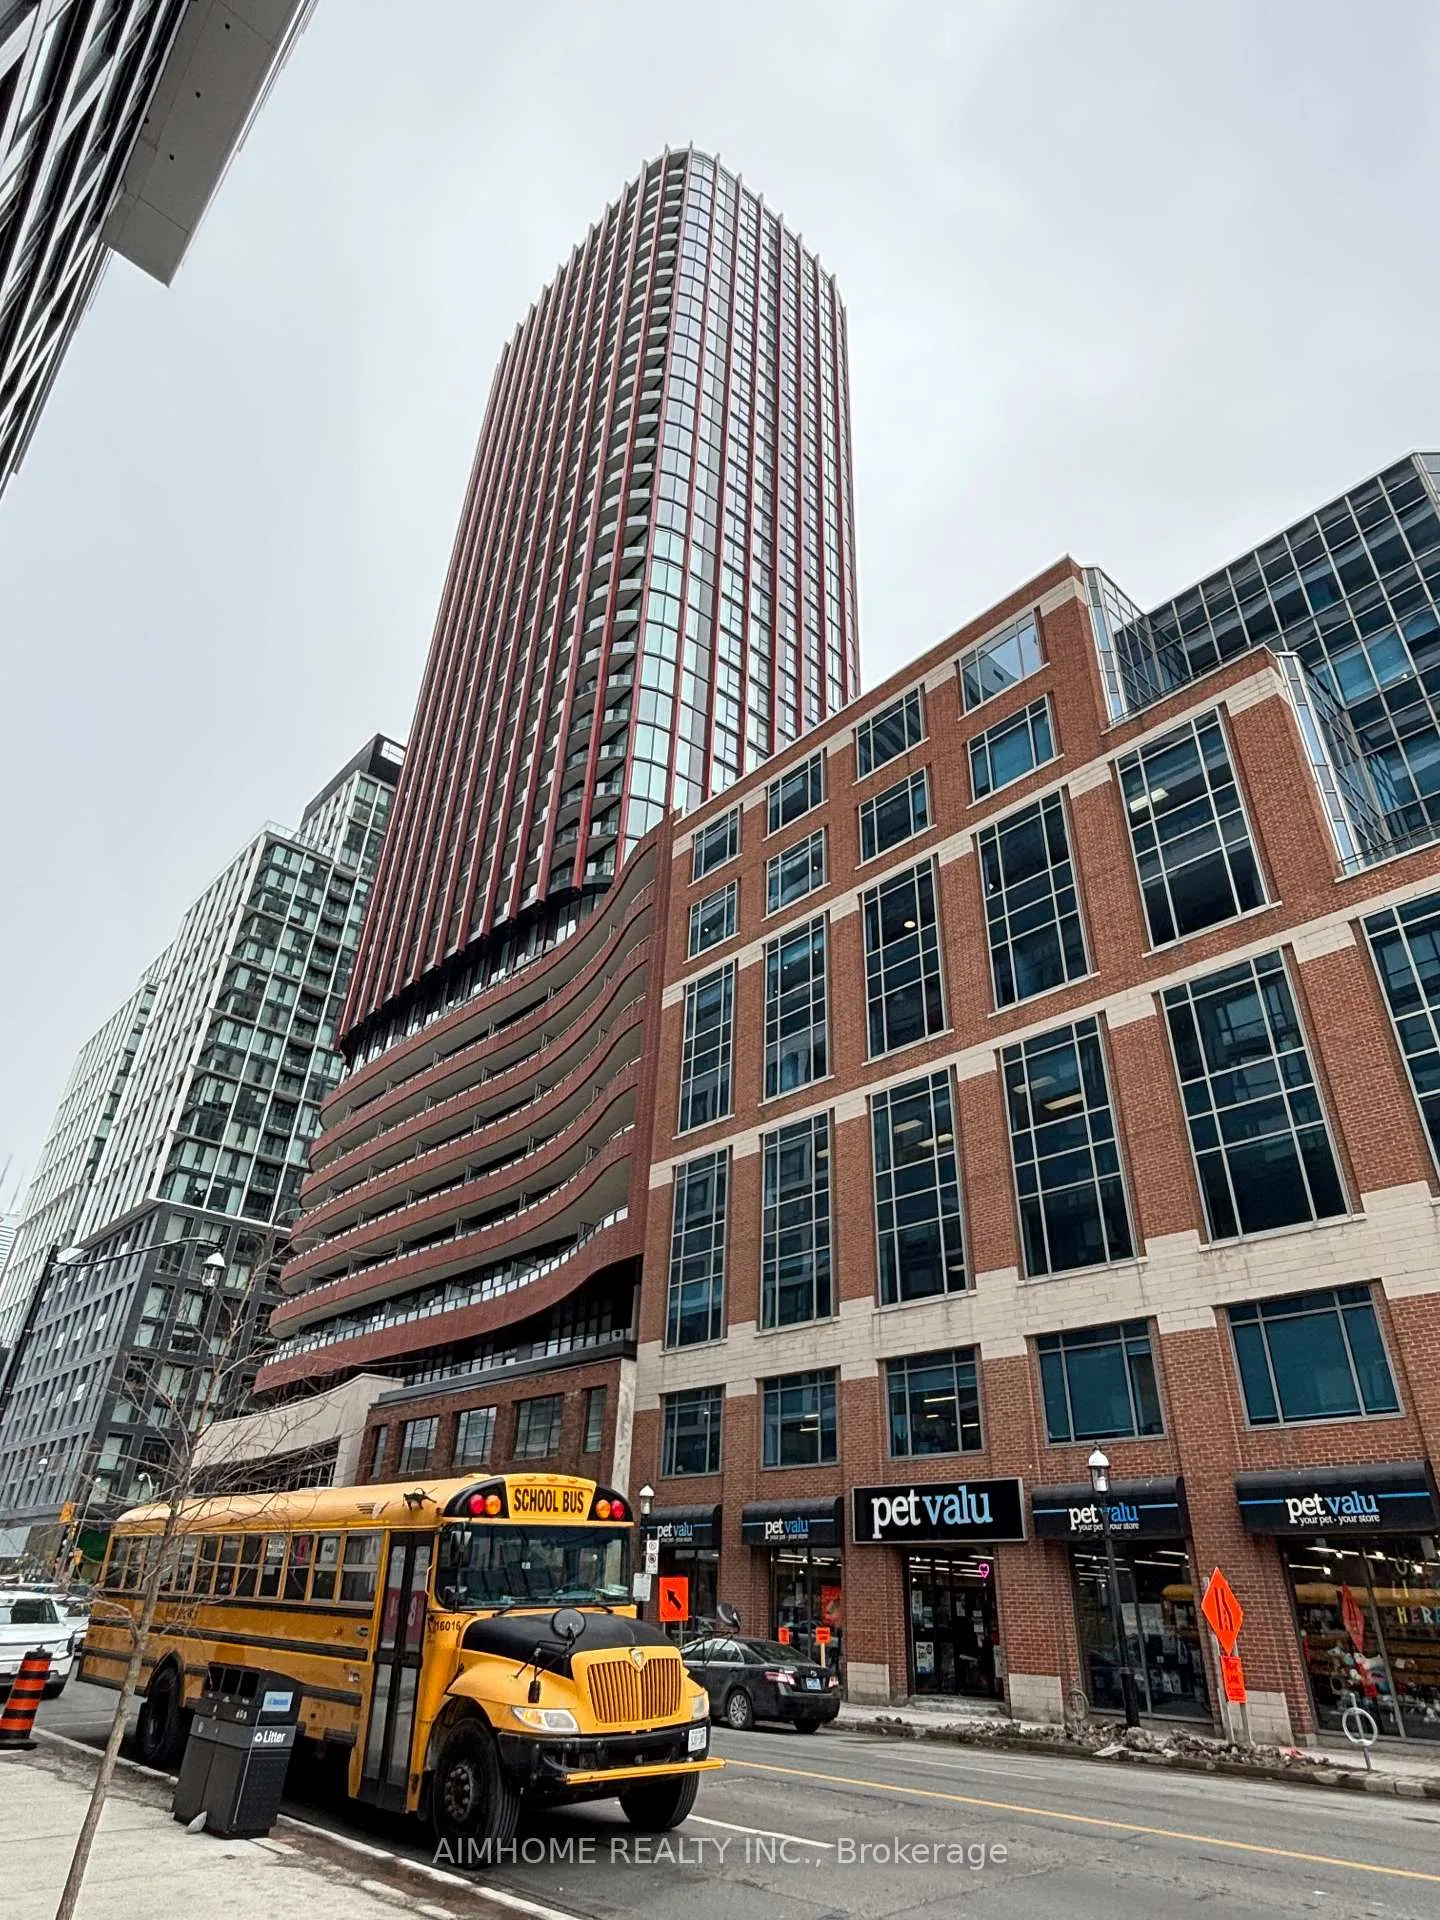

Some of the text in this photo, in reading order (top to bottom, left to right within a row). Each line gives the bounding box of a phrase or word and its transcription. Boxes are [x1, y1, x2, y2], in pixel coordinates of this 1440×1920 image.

[514, 1488, 584, 1513] SCHOOL BUS
[871, 1485, 993, 1539] pet valu
[1285, 1491, 1380, 1524] pet valu
[764, 1518, 783, 1539] pet
[784, 1516, 808, 1533] valu
[1069, 1504, 1099, 1531] pet
[1299, 1514, 1380, 1526] your pet your store
[657, 1521, 693, 1540] pet valu
[263, 1730, 287, 1744] Litter
